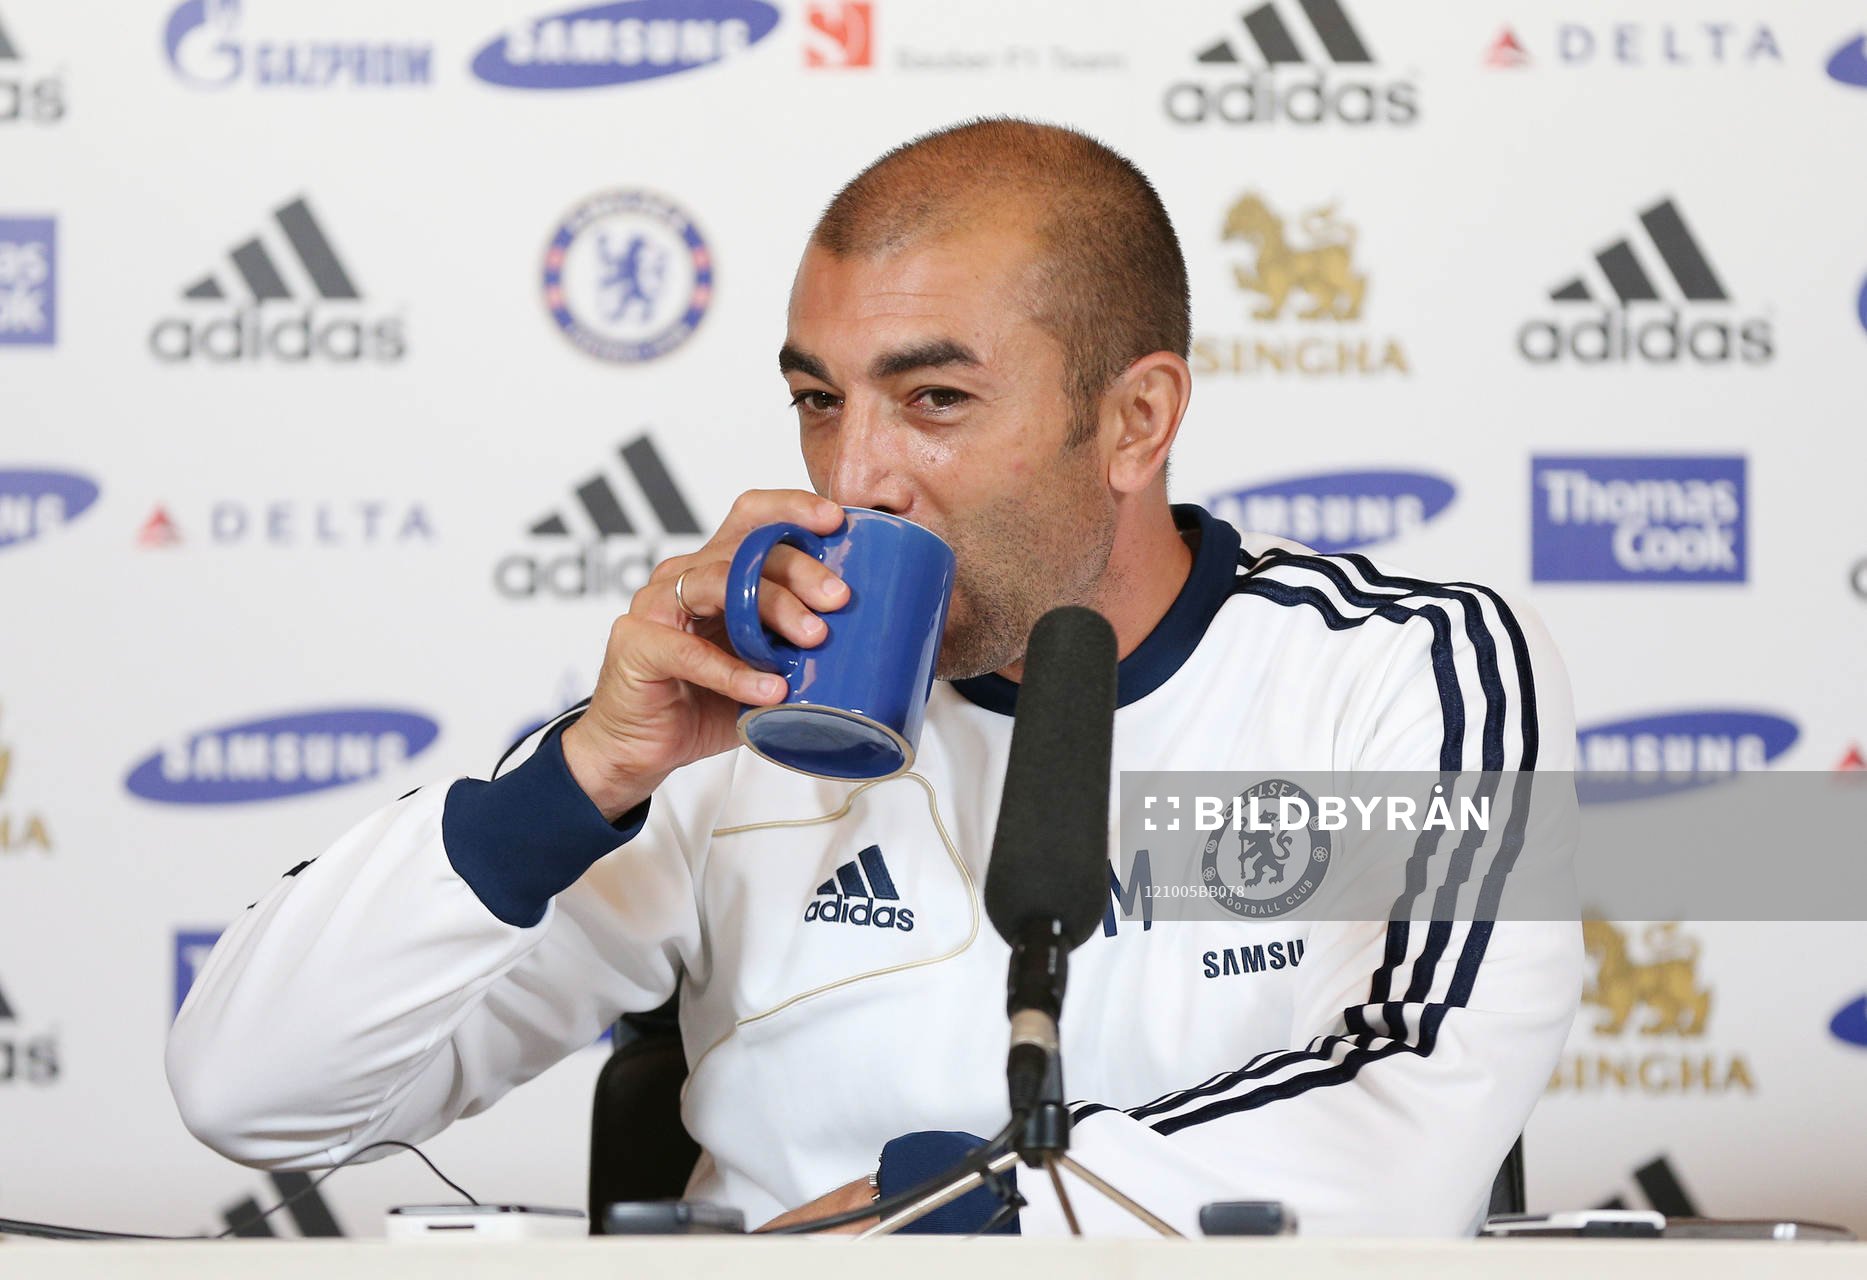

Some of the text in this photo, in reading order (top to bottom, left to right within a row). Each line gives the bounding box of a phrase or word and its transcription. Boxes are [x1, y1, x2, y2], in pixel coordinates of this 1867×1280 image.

[256, 42, 432, 86] GAZPROM
[504, 18, 750, 66] SAMSUNG
[1558, 25, 1784, 64] DELTA
[1164, 70, 1419, 126] adidas
[149, 308, 406, 364] adidas
[1193, 335, 1411, 377] SINGHA
[1517, 307, 1775, 365] adidas
[1211, 493, 1424, 545] AMSUNG
[1535, 468, 1740, 526] Thomas
[211, 503, 437, 544] DELTA
[1612, 520, 1739, 573] Cook
[493, 546, 656, 600] adid
[161, 730, 409, 783] SAMSUNG
[1577, 733, 1767, 784] MSUNG
[804, 893, 915, 932] adidas
[1286, 879, 1314, 906] CLUB
[1202, 938, 1306, 979] SAMSU
